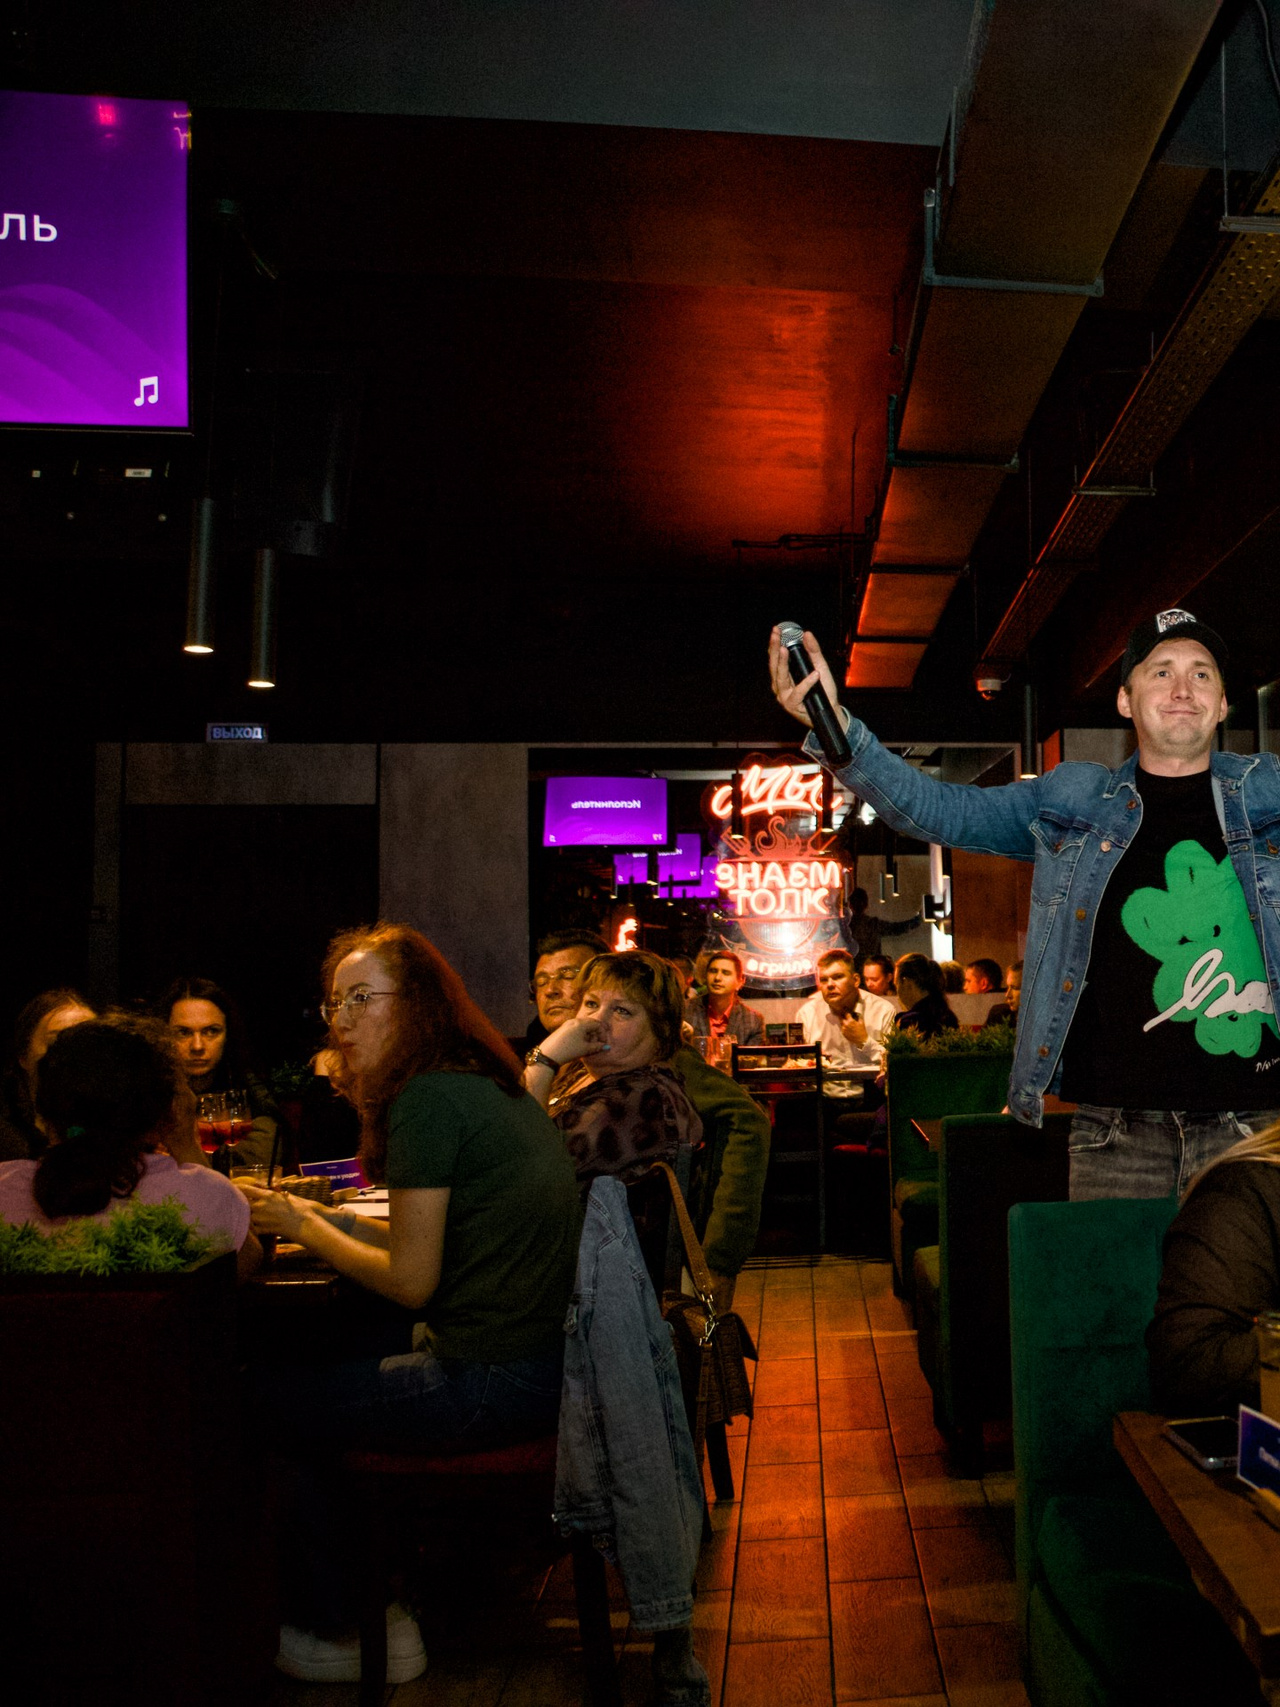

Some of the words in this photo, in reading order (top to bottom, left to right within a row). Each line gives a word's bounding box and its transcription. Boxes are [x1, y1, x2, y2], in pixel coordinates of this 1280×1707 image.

[212, 727, 263, 739] ВЫХОД
[714, 860, 840, 889] ЗНАЕМ
[728, 887, 829, 916] ТОЛК
